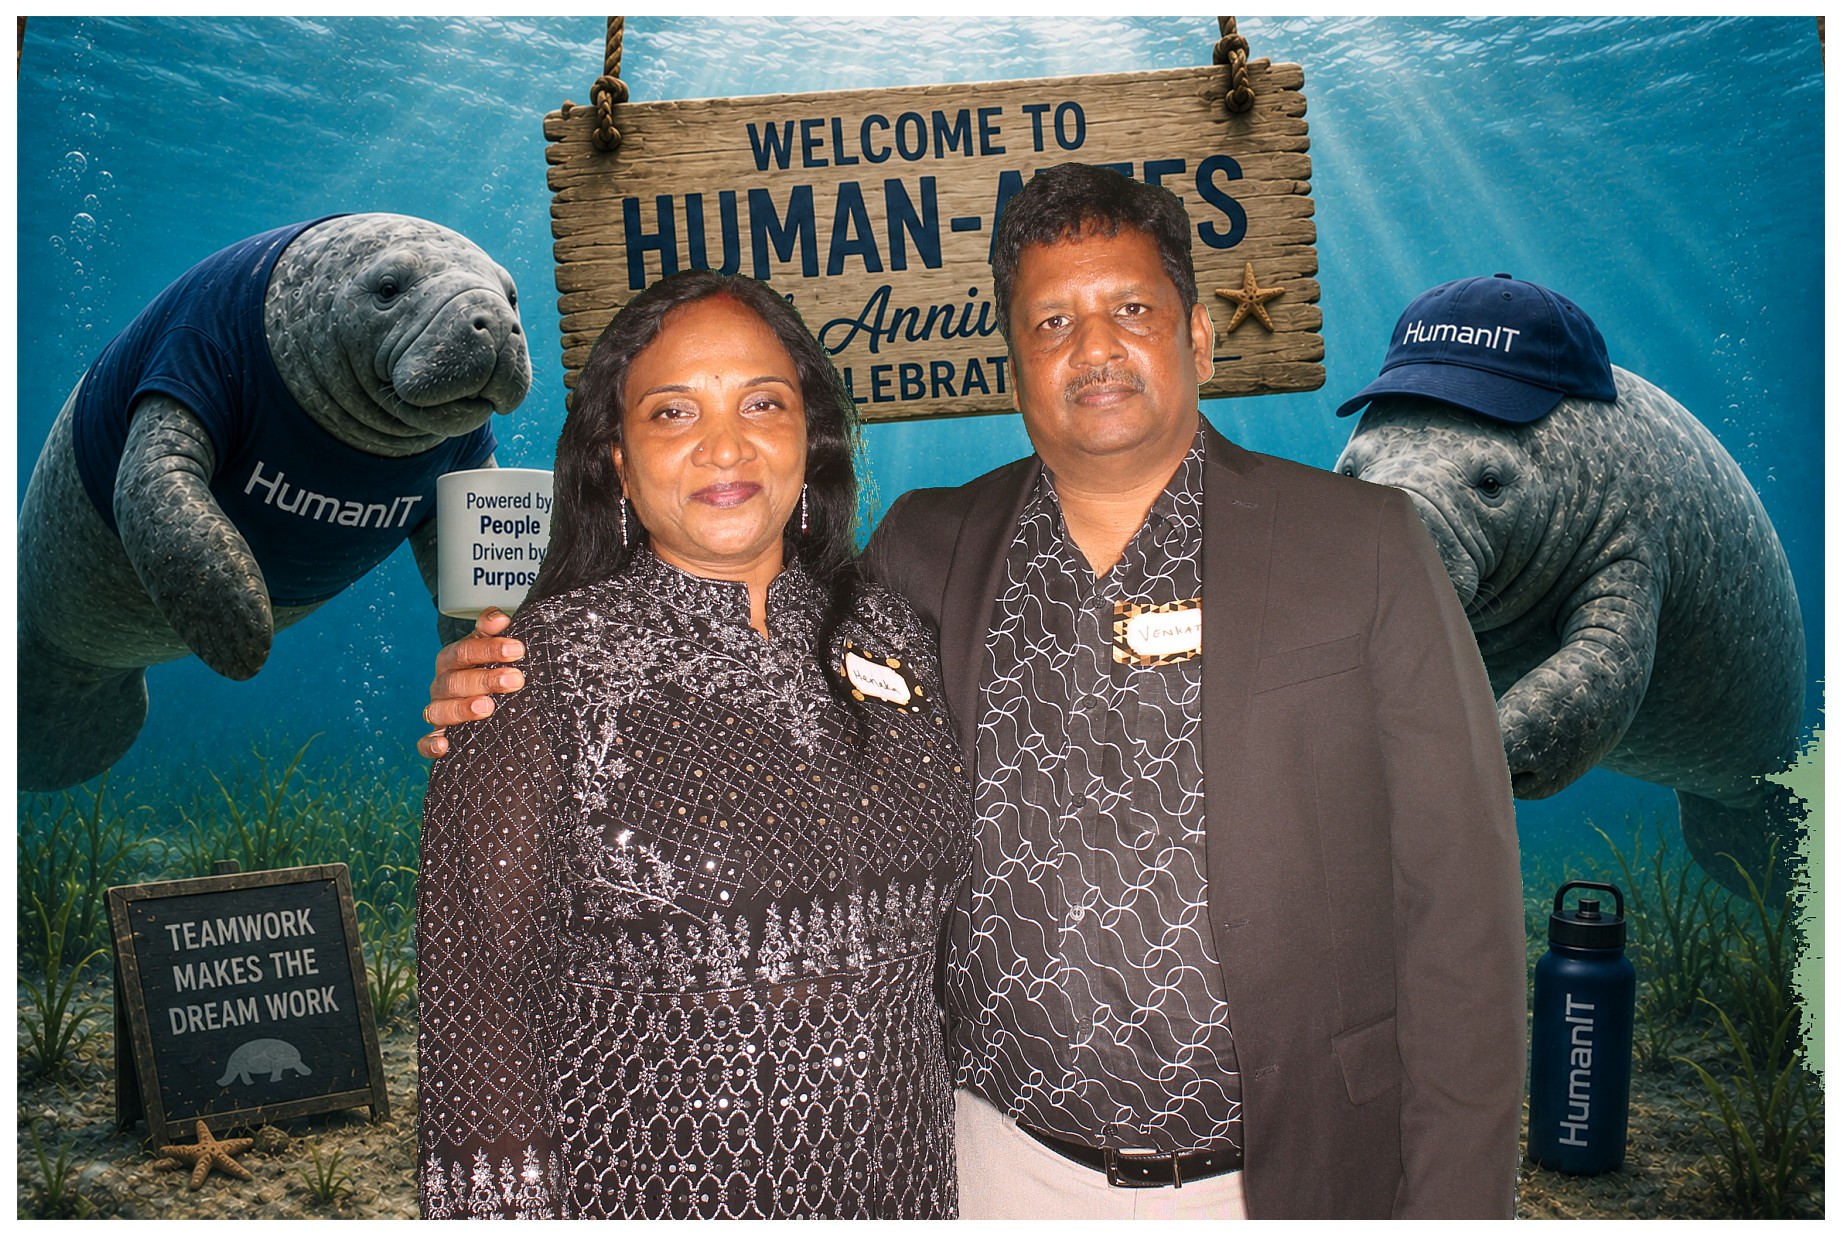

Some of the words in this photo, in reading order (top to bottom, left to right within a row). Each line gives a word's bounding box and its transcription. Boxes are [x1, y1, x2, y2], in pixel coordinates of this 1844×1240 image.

[746, 107, 1006, 172] WELCOME
[1022, 101, 1087, 152] TO
[1402, 319, 1520, 353] HumanIT
[843, 355, 1009, 404] LEBRAT
[244, 461, 423, 529] HumanIT
[467, 491, 531, 509] Powered
[536, 491, 552, 514] by
[480, 515, 541, 539] People
[473, 542, 523, 560] Driven
[529, 542, 546, 565] by
[473, 567, 536, 591] Purpos
[165, 908, 315, 951] TEAMWORK
[172, 954, 263, 993] MAKES
[269, 948, 319, 978] THE
[168, 997, 260, 1035] DREAM
[264, 985, 340, 1021] WORK
[1559, 993, 1595, 1147] HumanIT
